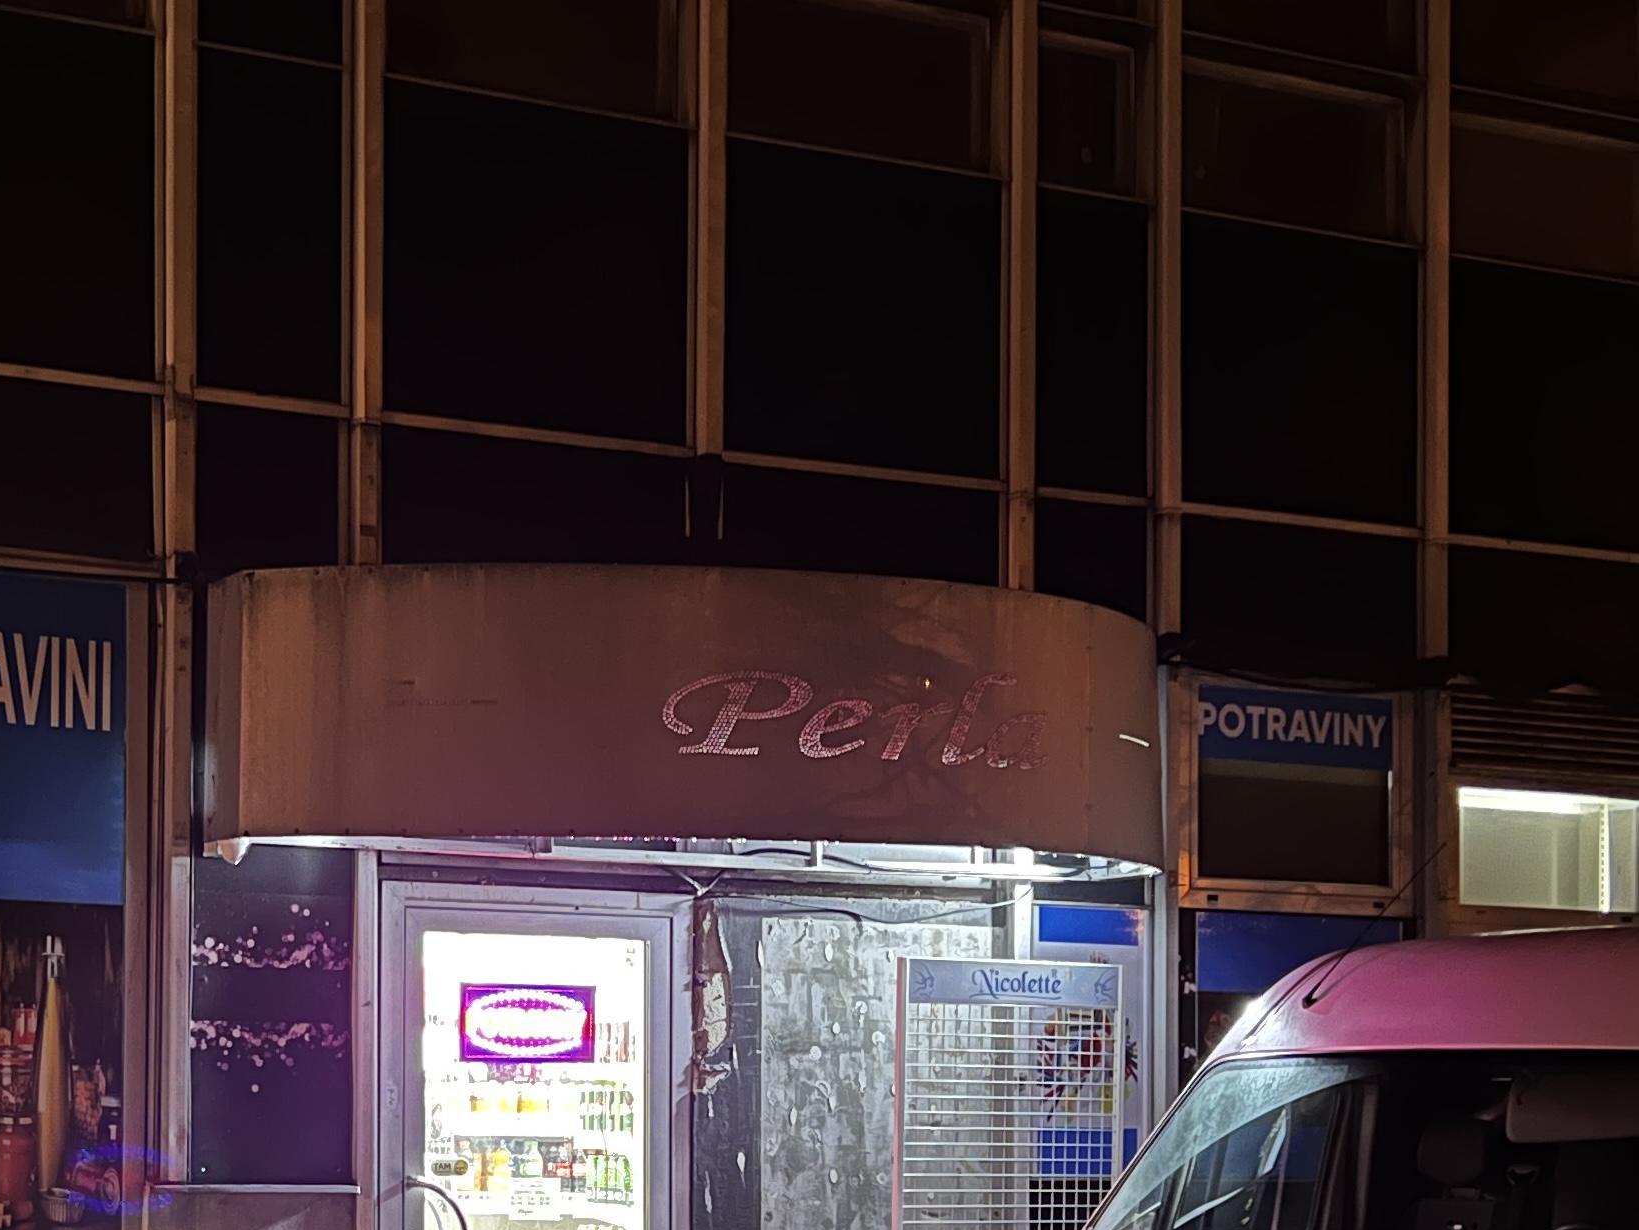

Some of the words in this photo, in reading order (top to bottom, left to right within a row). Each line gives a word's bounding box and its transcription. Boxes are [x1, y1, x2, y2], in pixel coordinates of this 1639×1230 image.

[661, 670, 1049, 771] Perla
[1198, 701, 1388, 749] POTRAVINY
[970, 968, 1063, 1000] Nicolette
